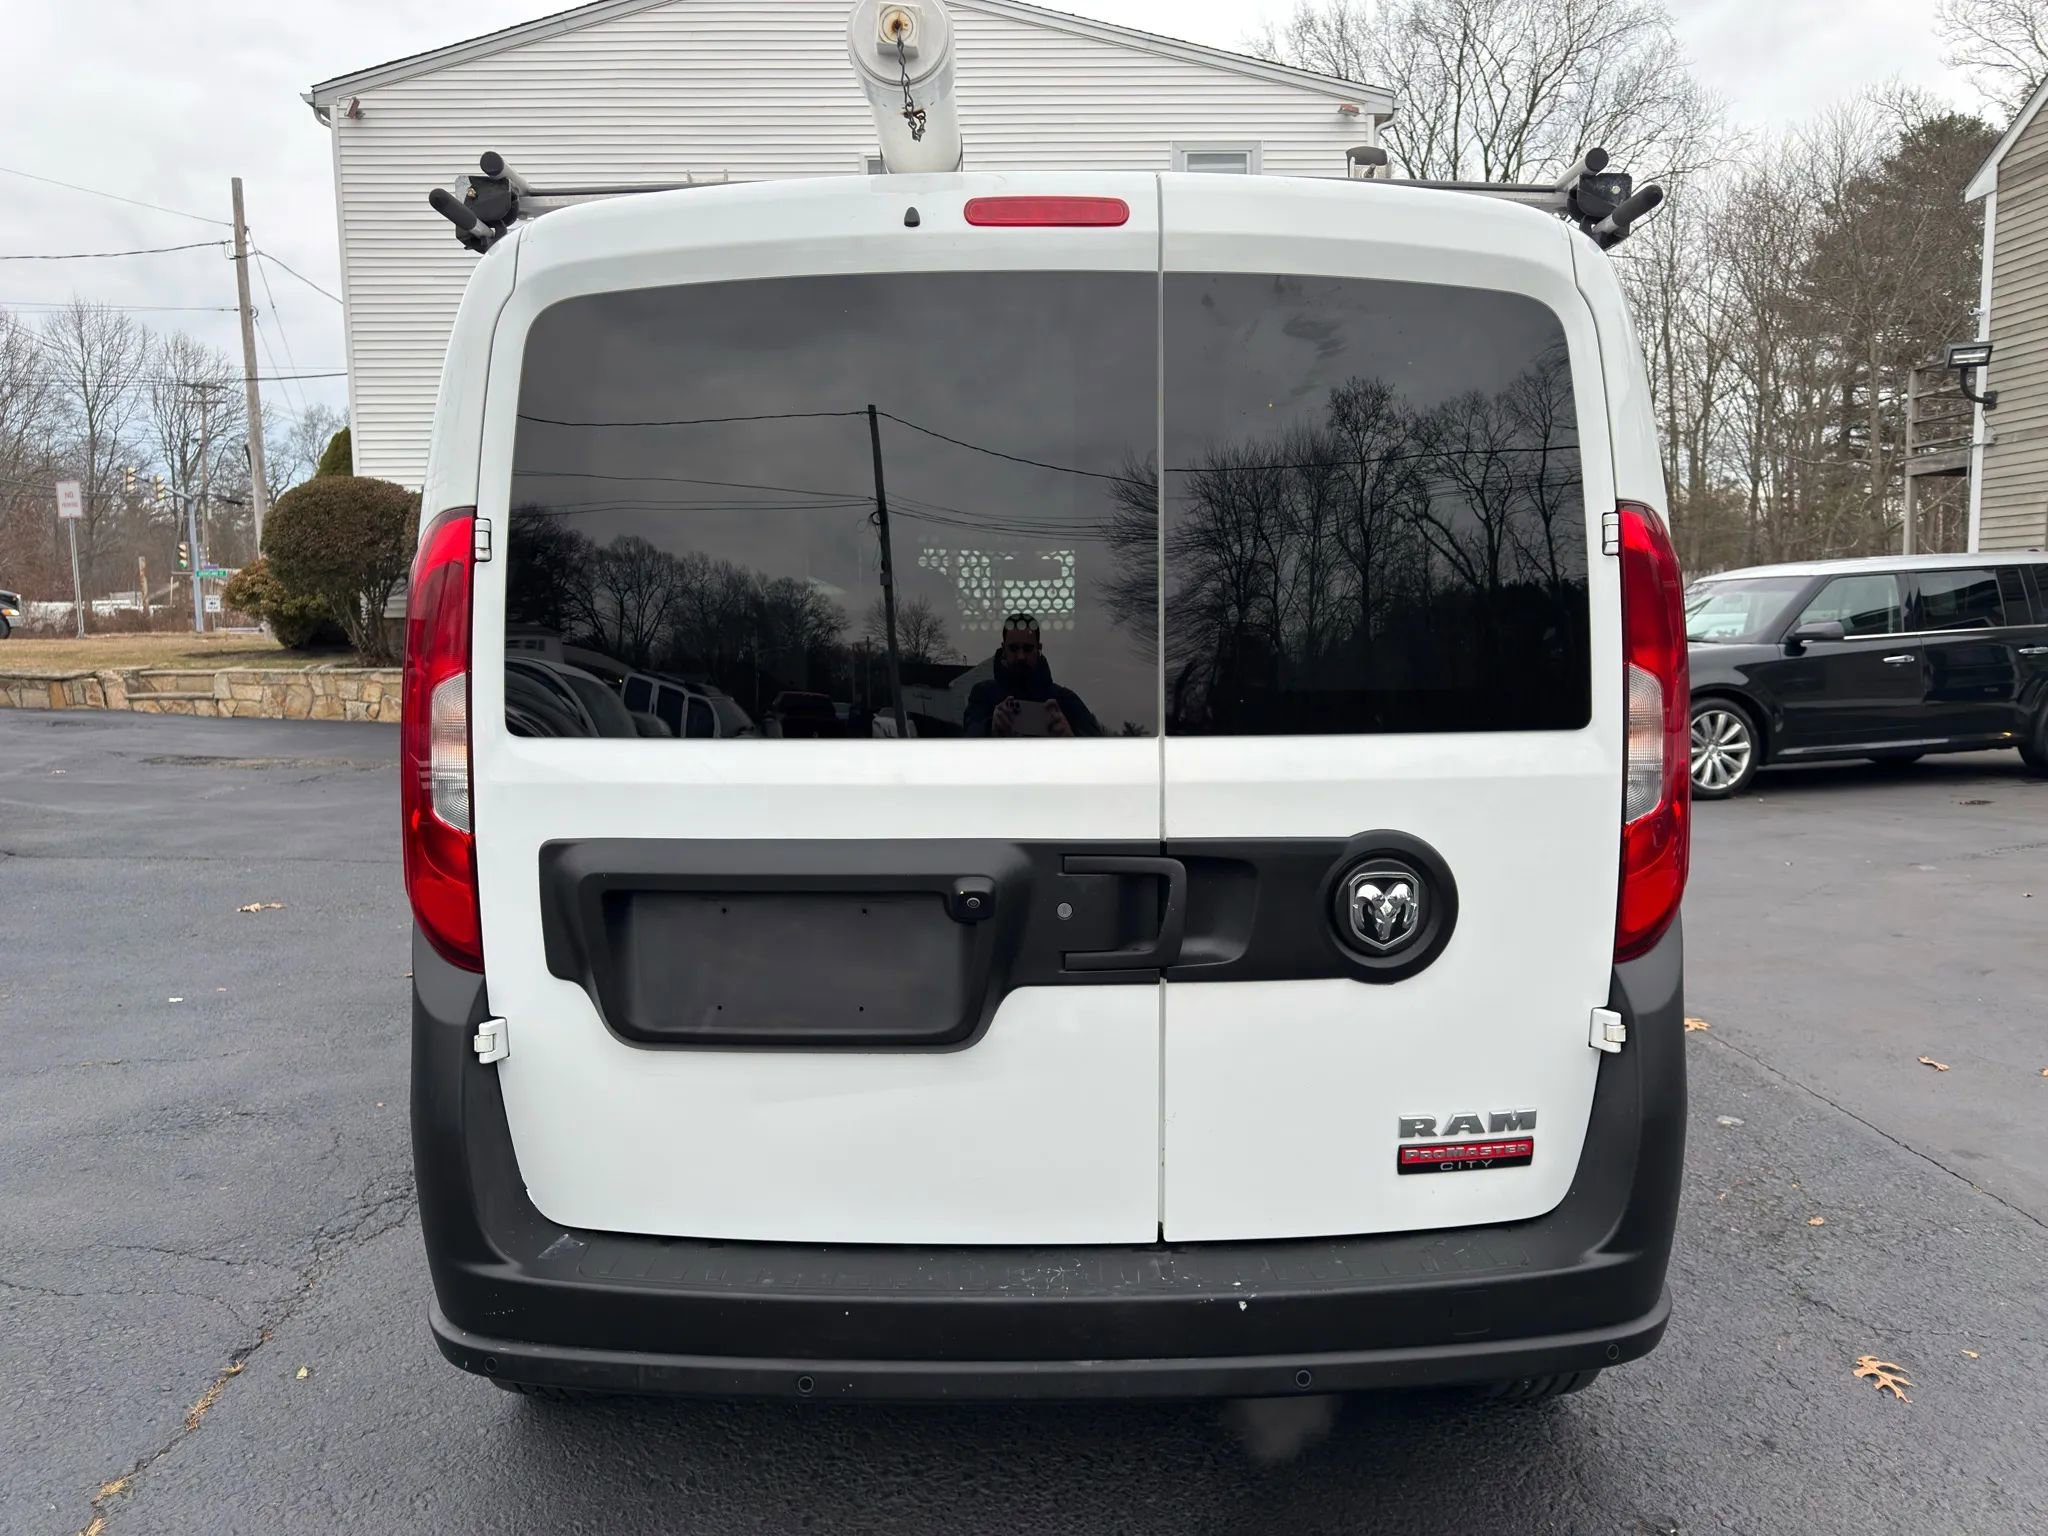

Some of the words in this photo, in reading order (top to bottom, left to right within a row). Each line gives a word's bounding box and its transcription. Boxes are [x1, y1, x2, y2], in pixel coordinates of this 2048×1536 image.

[1399, 1108, 1537, 1138] RAM
[1405, 1143, 1529, 1160] PROMASTER
[1440, 1159, 1494, 1171] CITY
